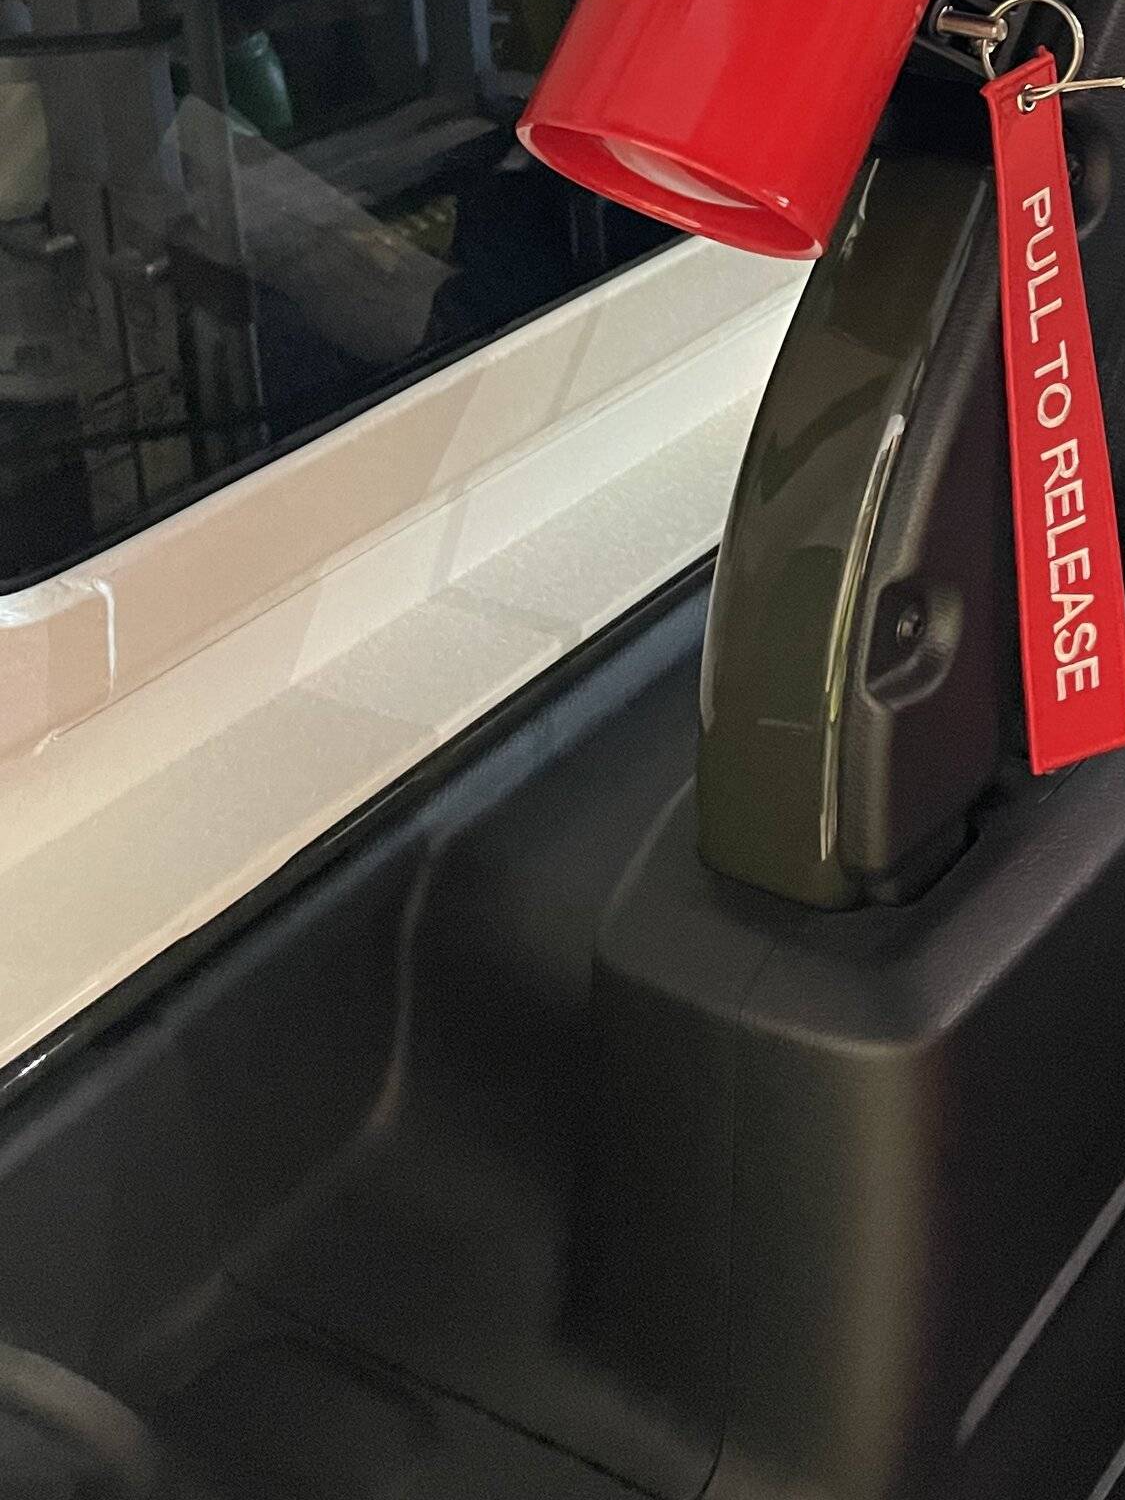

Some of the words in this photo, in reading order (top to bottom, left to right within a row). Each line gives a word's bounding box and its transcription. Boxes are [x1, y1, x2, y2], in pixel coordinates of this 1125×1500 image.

[1022, 186, 1063, 344] PULL
[1034, 340, 1072, 429] TO
[1040, 438, 1100, 702] RELEASE
